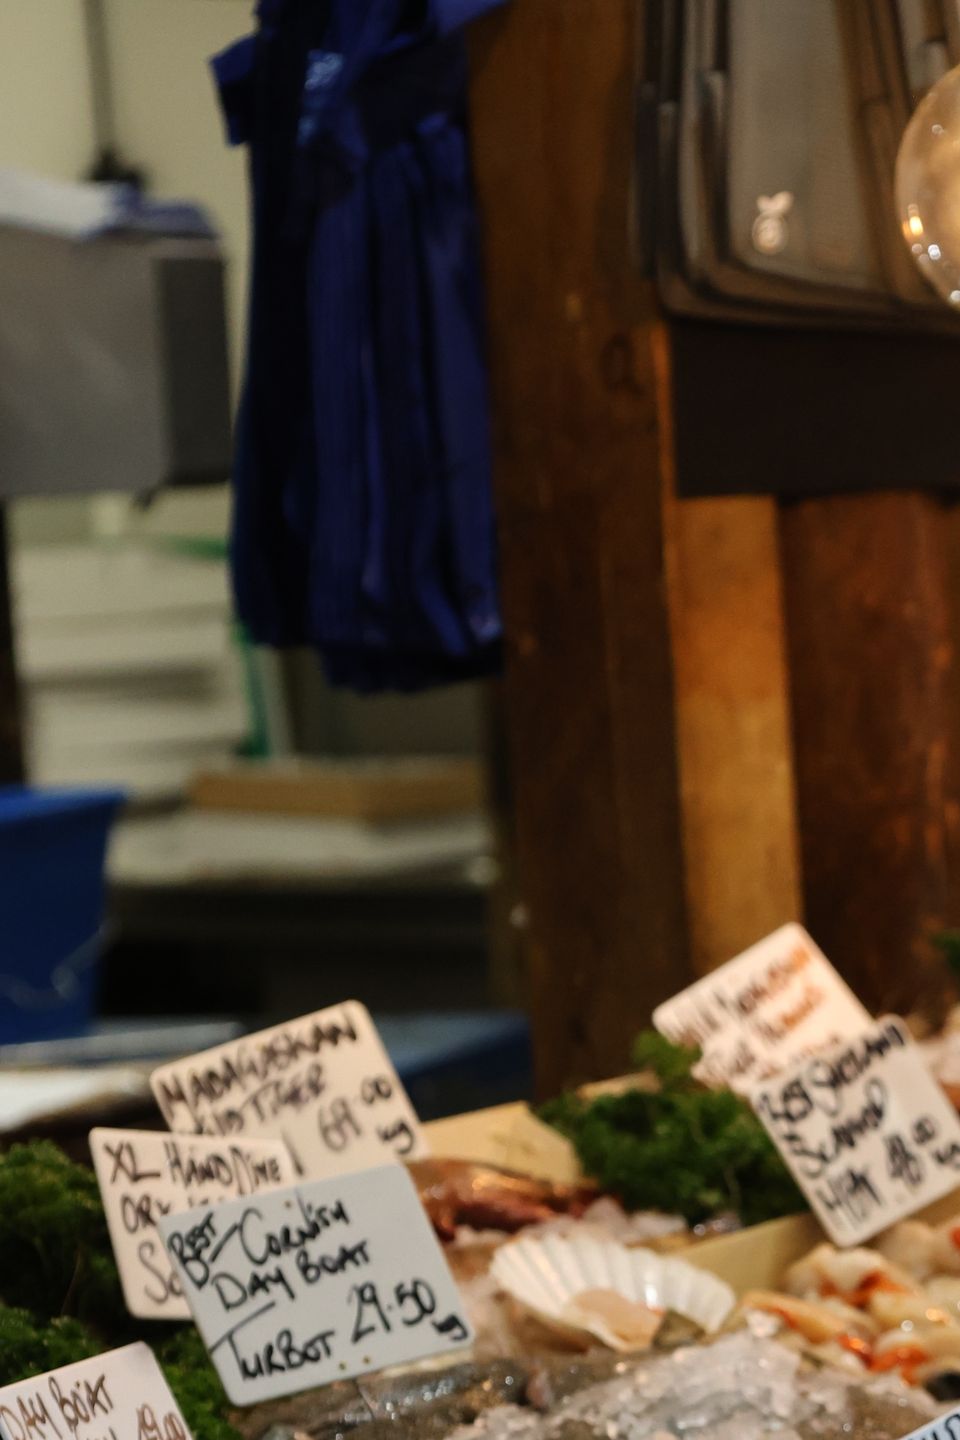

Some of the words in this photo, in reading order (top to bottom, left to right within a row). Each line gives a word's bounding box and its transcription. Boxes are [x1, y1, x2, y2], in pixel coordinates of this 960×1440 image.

[103, 1141, 161, 1184] XL
[168, 1212, 216, 1289] BEST
[211, 1268, 295, 1311] DAY
[298, 1240, 370, 1285] BOAT
[210, 1302, 336, 1381] TURBOT
[48, 1374, 114, 1431] BOAT
